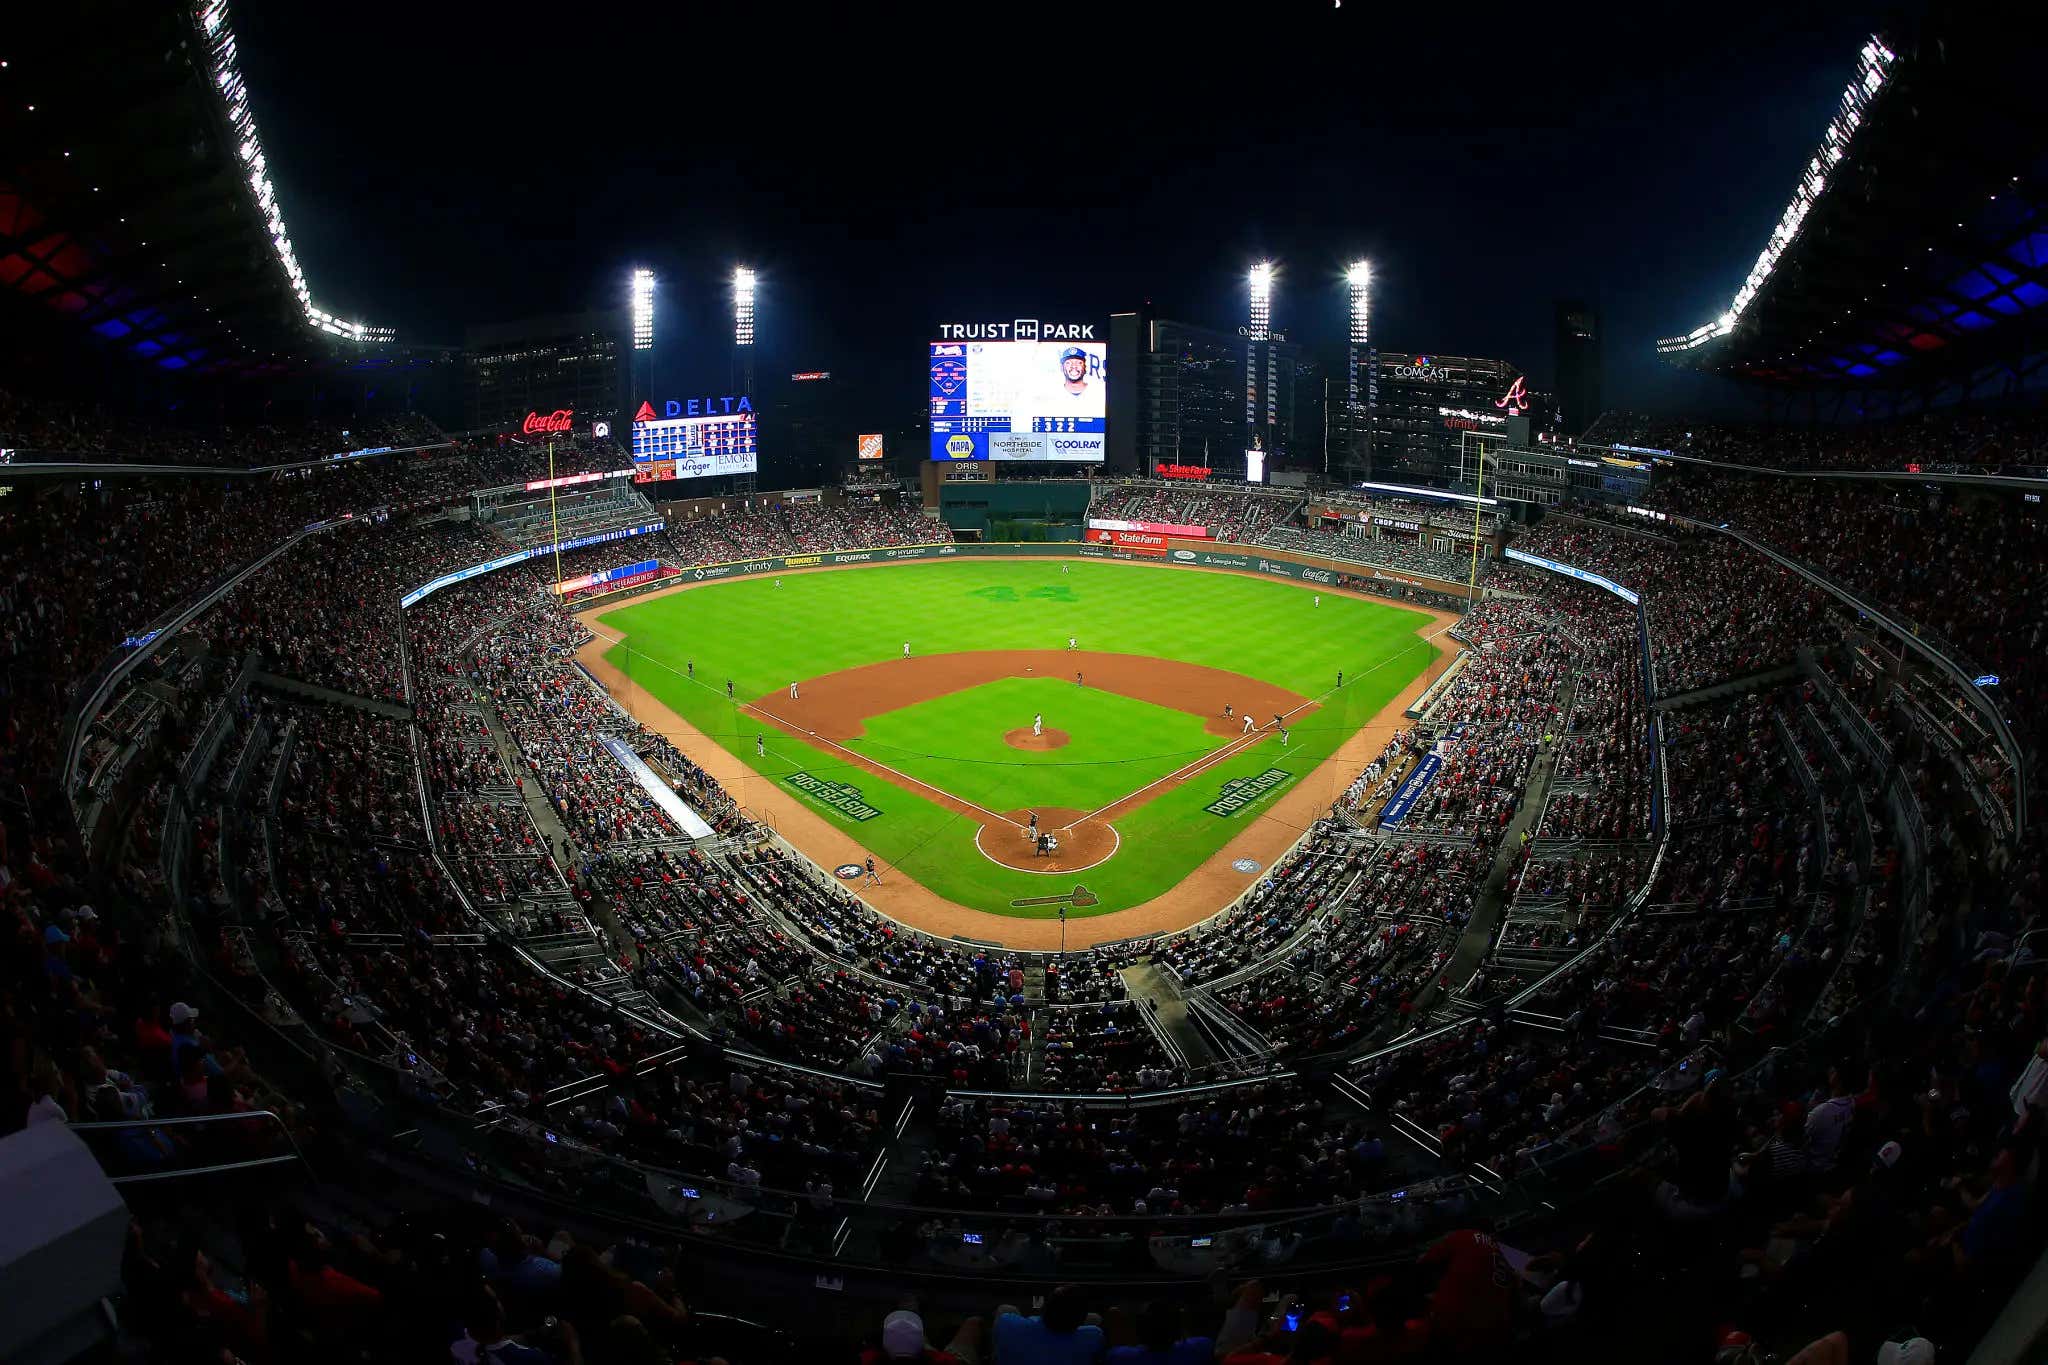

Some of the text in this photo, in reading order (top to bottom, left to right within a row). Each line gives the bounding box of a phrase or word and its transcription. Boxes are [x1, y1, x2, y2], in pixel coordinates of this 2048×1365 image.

[940, 324, 1094, 339] TRUIST PARK
[1394, 366, 1450, 379] COMCAST
[666, 396, 753, 416] DELTA
[1044, 421, 1075, 431] 3 2 2
[1444, 417, 1479, 431] xfinity
[950, 441, 970, 452] NAPA
[1055, 440, 1101, 448] COOLRAY
[718, 454, 754, 464] EMORY
[682, 459, 711, 475] Kroger
[955, 462, 979, 470] ORIS
[1374, 517, 1419, 531] CHOP HOUSE
[835, 553, 871, 563] EQUIFAX
[1212, 558, 1231, 566] Georgia
[743, 560, 773, 574] xfinity
[620, 576, 640, 587] LEADER
[786, 772, 879, 820] POSTSEASON
[1207, 769, 1289, 816] POSTSEASON
